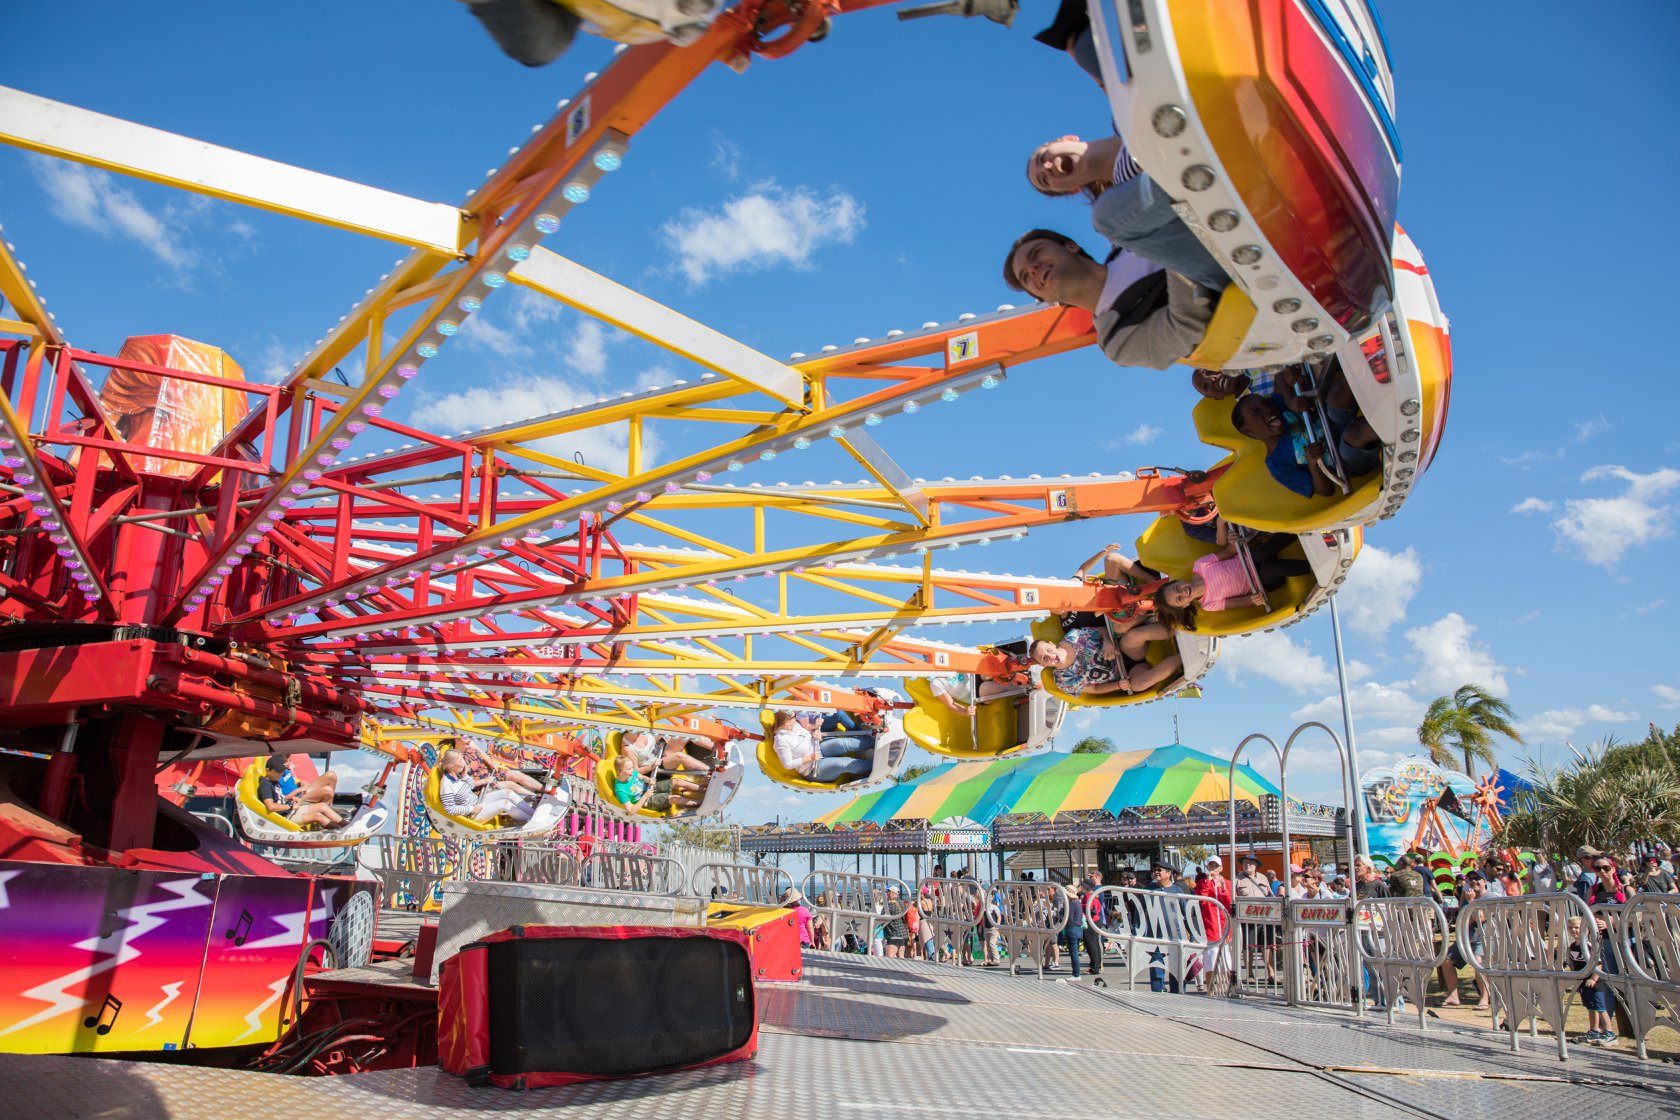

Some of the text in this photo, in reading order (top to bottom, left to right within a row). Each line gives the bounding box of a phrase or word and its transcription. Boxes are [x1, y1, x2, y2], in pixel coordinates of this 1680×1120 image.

[956, 338, 970, 359] 7
[1057, 493, 1067, 508] 6
[1025, 591, 1035, 603] 5
[949, 833, 985, 845] DODGEMS
[1245, 904, 1273, 917] EXIT
[1301, 907, 1340, 921] ENTRY
